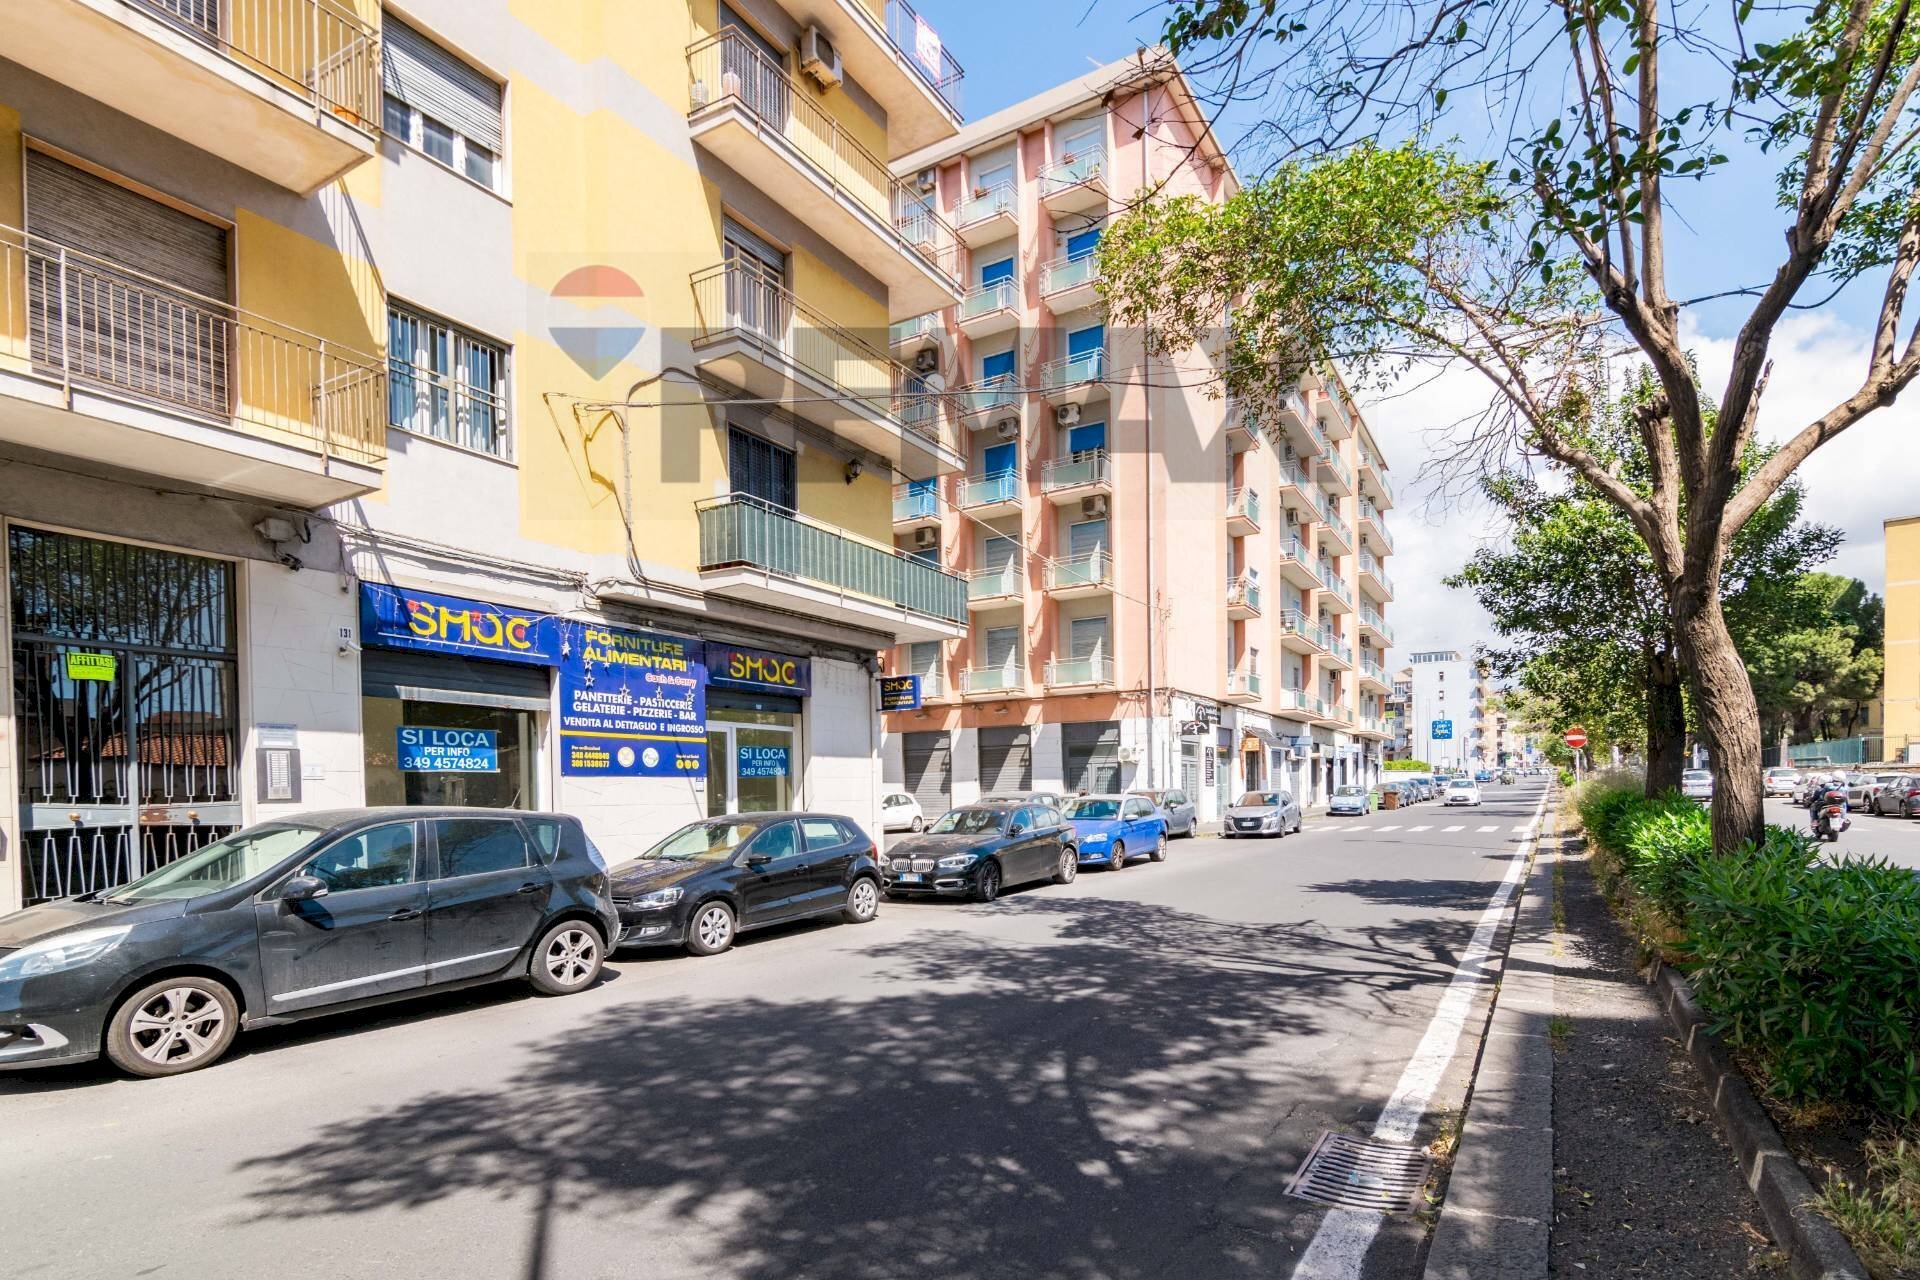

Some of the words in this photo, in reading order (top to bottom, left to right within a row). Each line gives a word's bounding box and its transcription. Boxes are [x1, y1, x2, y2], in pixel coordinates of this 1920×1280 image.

[585, 630, 684, 656] FORNITURE
[582, 646, 687, 672] ALIMENTARI
[574, 690, 632, 705] PANETTERIE
[640, 697, 693, 711] PASTICCERIE
[573, 702, 625, 715] GELATERIE
[633, 707, 672, 719] PIZZERIE
[679, 710, 697, 721] BAR
[564, 717, 602, 728] VENDITA
[603, 719, 613, 729] AL
[615, 720, 657, 731] DETTAGLIO
[667, 724, 704, 734] INGROSSO
[401, 729, 423, 745] SI
[432, 730, 489, 747] LOCA
[424, 746, 444, 756] PER
[447, 747, 470, 757] INFO
[740, 748, 752, 759] SI
[756, 748, 786, 760] LOCA
[404, 757, 430, 768] 349
[434, 758, 488, 769] 4574824
[741, 767, 755, 776] 349
[752, 759, 762, 767] PER
